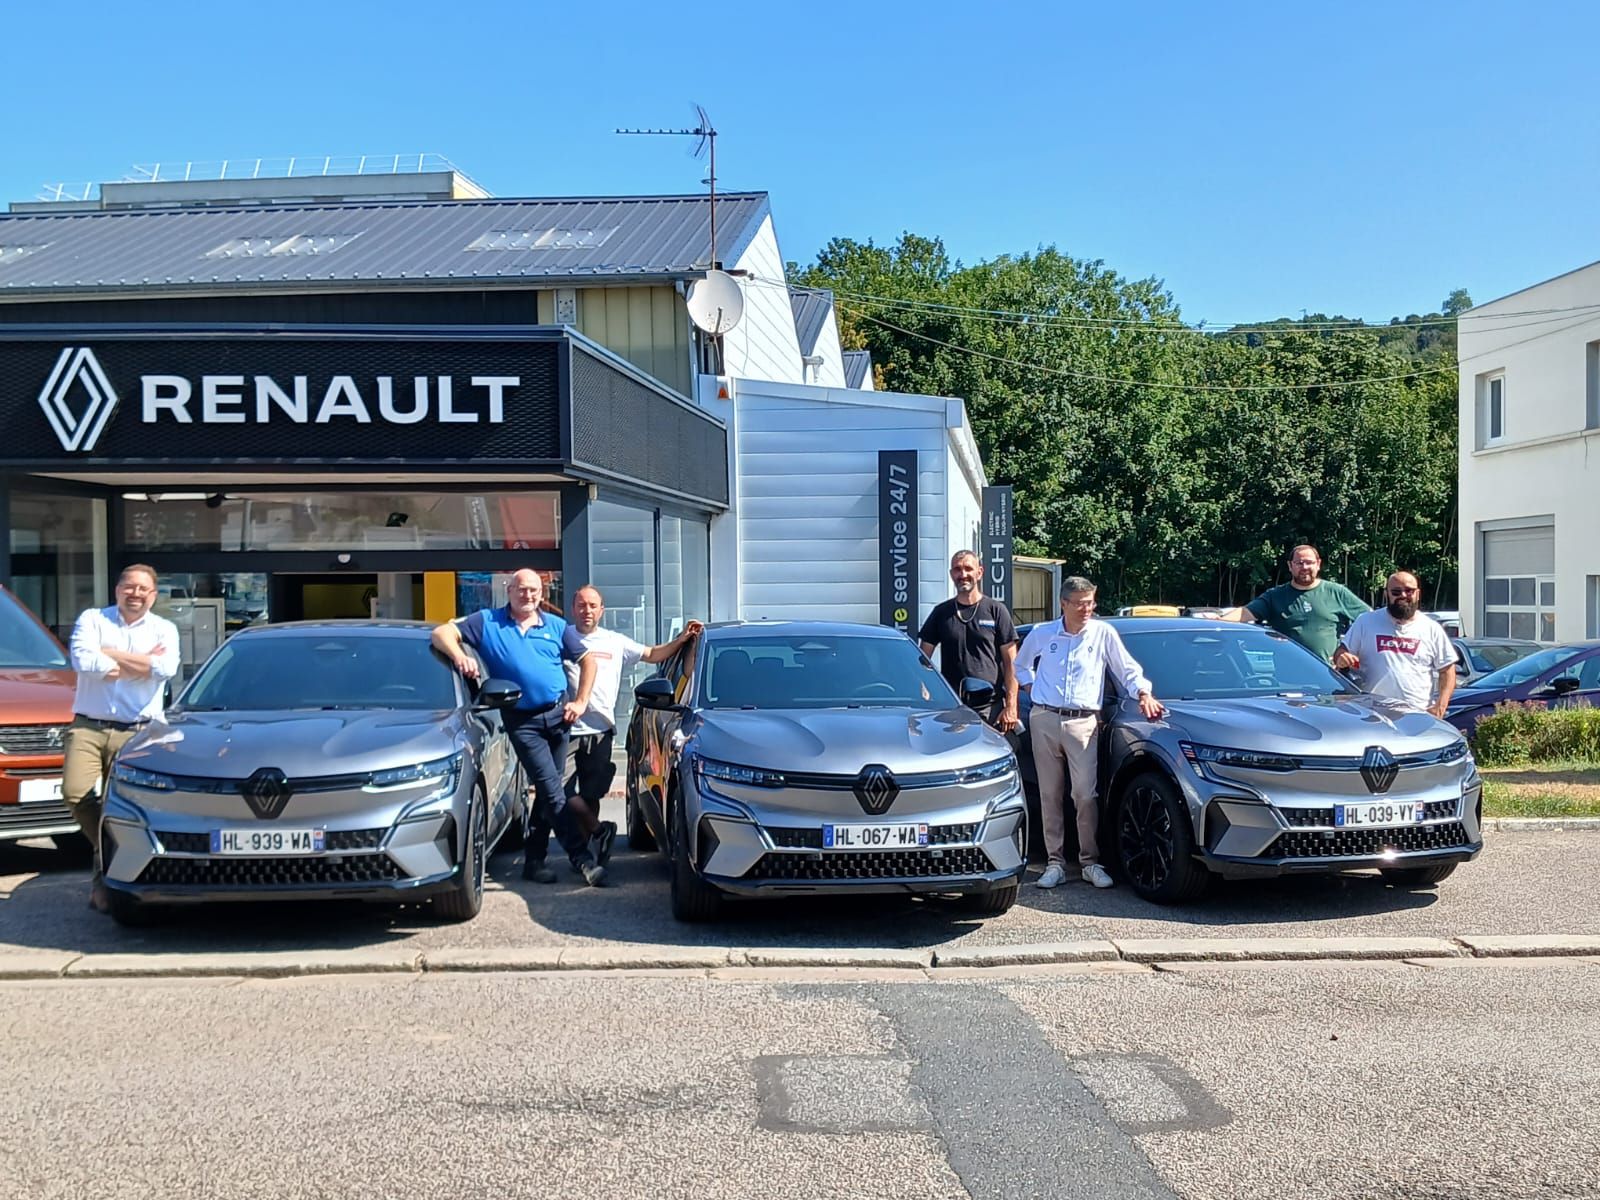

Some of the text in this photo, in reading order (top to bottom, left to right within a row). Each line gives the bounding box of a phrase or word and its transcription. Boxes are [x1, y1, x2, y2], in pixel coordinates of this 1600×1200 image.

[140, 375, 522, 424] RENAULT
[889, 464, 910, 632] re service 24/7
[991, 543, 1005, 602] ECH
[1346, 804, 1414, 824] HL-039-VY
[223, 832, 312, 851] HL-939-WA
[835, 827, 916, 845] HL-067-WA
